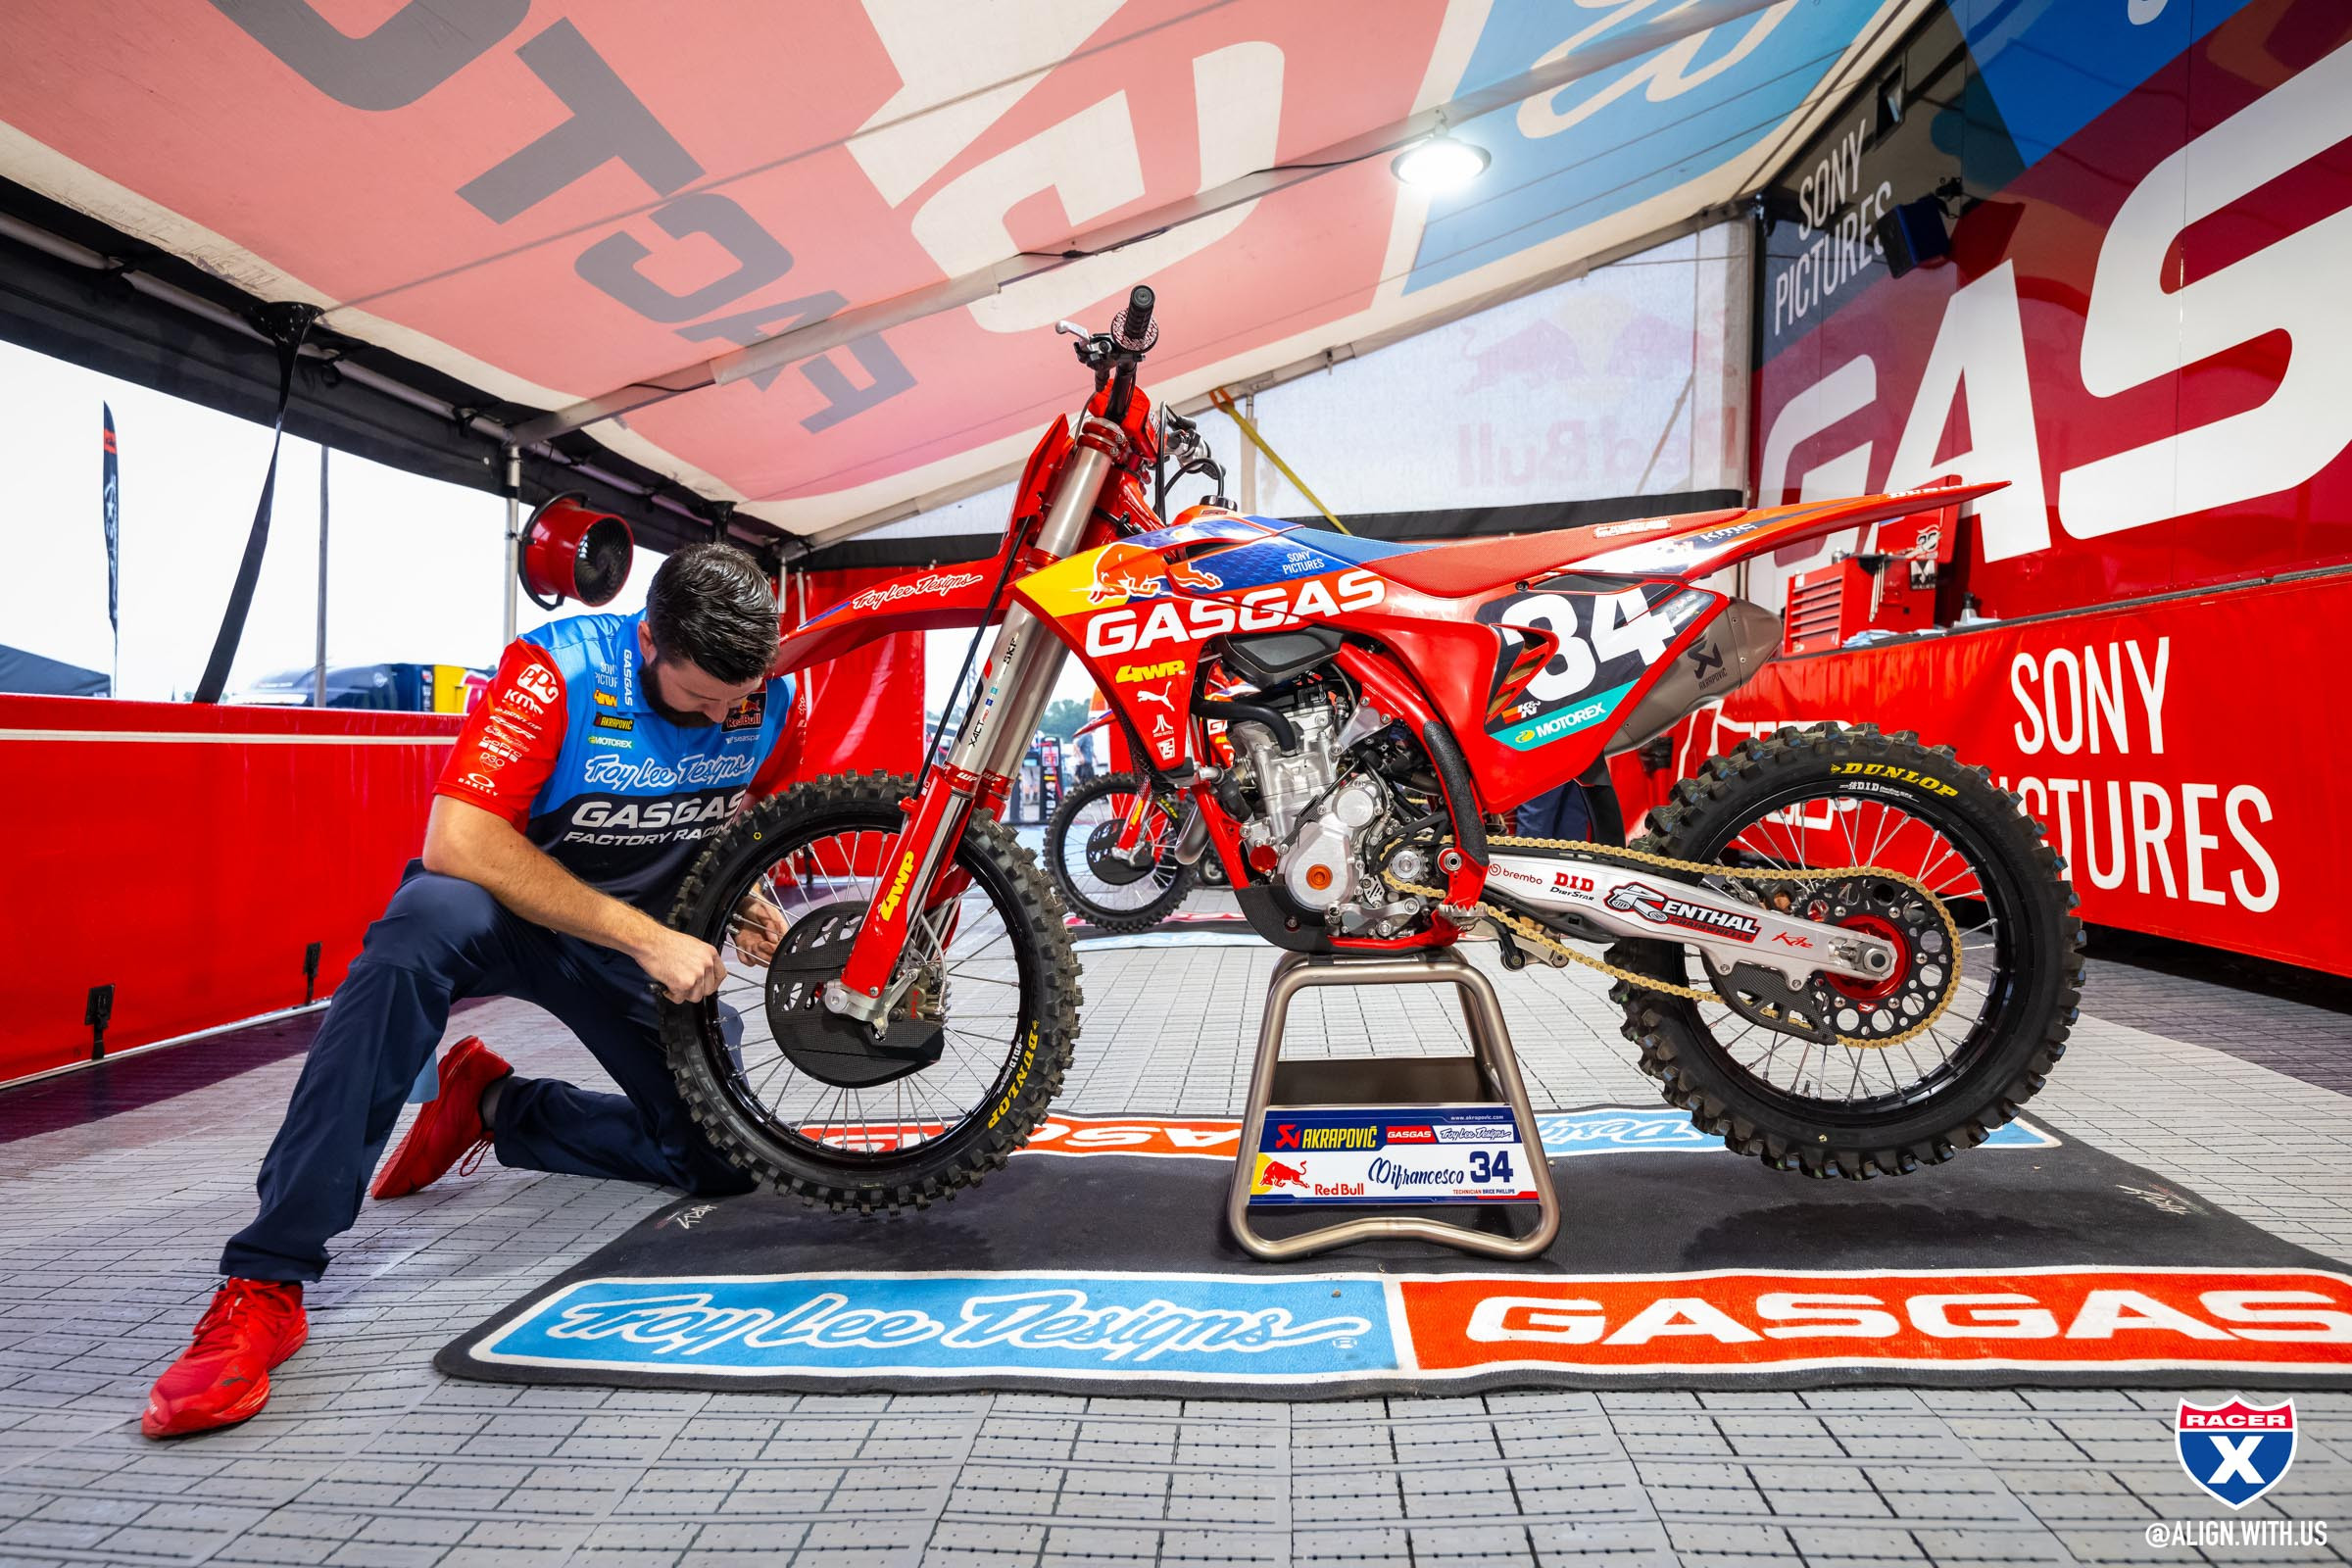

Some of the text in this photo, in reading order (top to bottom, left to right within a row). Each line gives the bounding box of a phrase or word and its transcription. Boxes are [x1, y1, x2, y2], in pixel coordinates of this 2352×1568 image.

[1797, 118, 1867, 242] SONY
[1282, 558, 1326, 575] PICTURES
[1286, 551, 1312, 564] SONY
[1085, 569, 1387, 659] GASGAS
[1003, 637, 1020, 664] SKF
[1500, 586, 1677, 702] 34
[2010, 636, 2169, 755] SONY
[1536, 702, 1607, 738] MOTOREX
[1840, 762, 1959, 798] DUNLOP
[571, 789, 747, 829] GASGAS
[564, 817, 736, 847] FACTORY RACIN
[1502, 867, 1544, 886] brembo
[987, 1029, 1039, 1130] DUNLOP
[1387, 1130, 1432, 1139] GASGAS
[1458, 1127, 1476, 1140] Lee
[1469, 1150, 1514, 1184] 34
[1314, 1183, 1364, 1196] Red Bull
[742, 1292, 943, 1348] Lee
[1464, 1289, 2352, 1348] GASGAS
